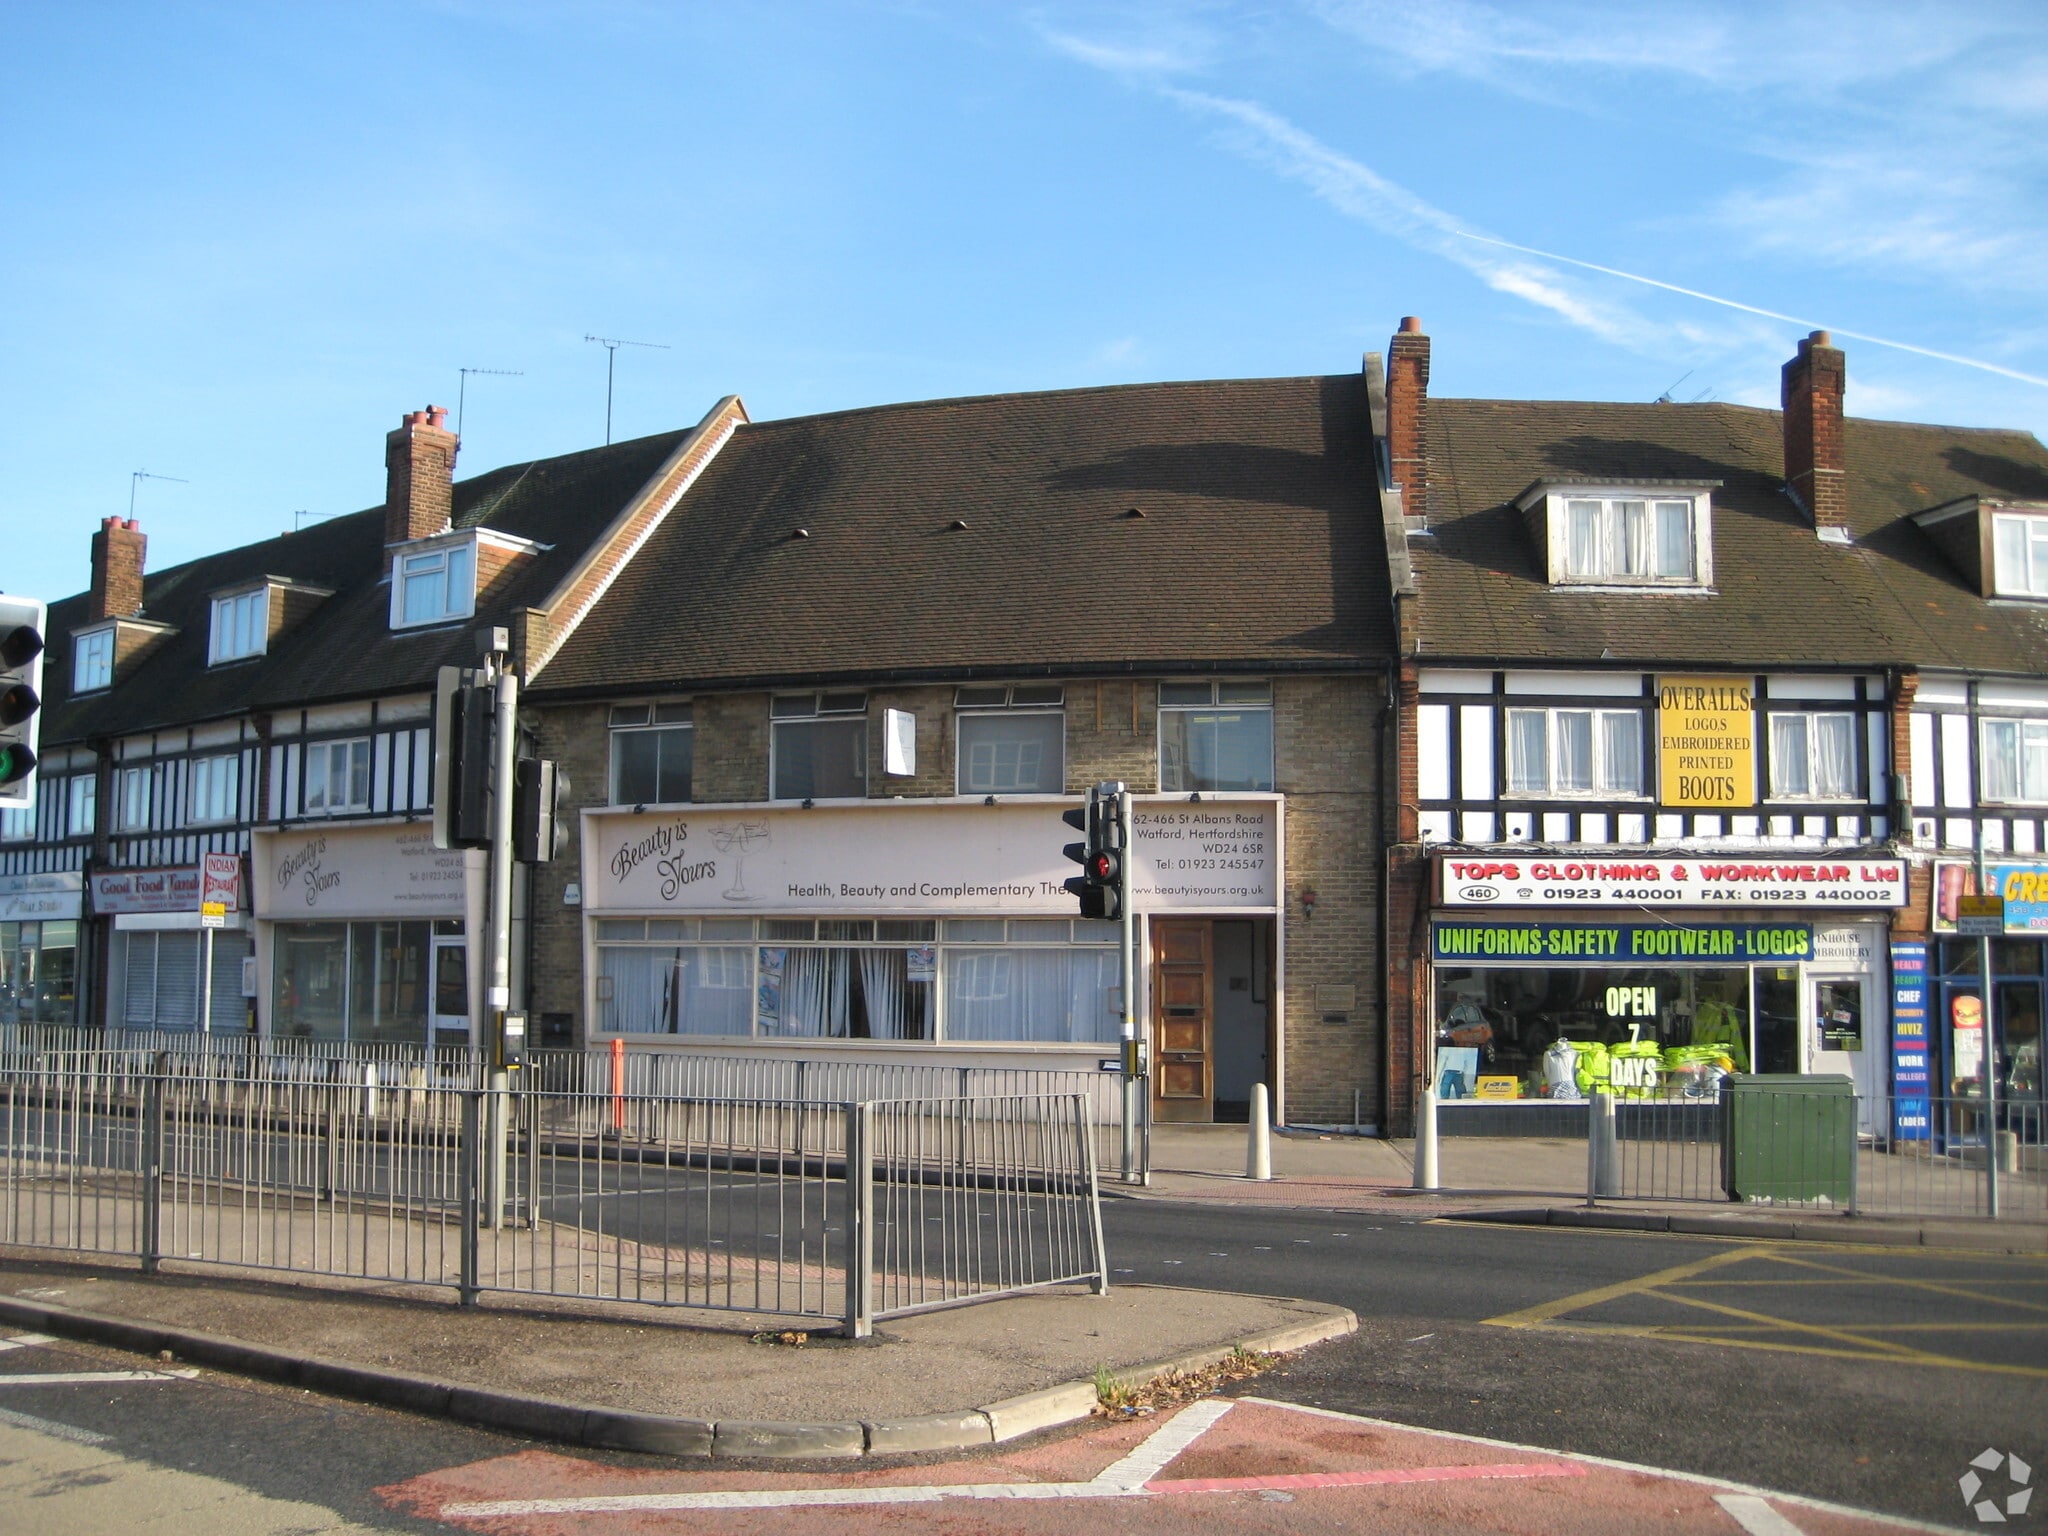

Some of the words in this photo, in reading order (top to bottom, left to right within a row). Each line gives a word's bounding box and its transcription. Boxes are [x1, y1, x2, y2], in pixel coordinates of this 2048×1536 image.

[1661, 686, 1749, 712] OVERALLS
[1662, 736, 1750, 750] EMBROIDERED
[1679, 756, 1733, 769] PRINTED
[1679, 776, 1735, 801] BOOTS
[1133, 814, 1175, 824] 62-466
[1179, 814, 1189, 824] St
[1192, 814, 1232, 824] Albans
[1235, 814, 1264, 824] Road
[1137, 828, 1185, 840] Watford,
[1189, 828, 1264, 839] Hertfordshire
[611, 824, 672, 883] Beauty
[675, 818, 687, 840] is
[1203, 844, 1238, 854] WD24
[1242, 844, 1264, 854] 6SR
[208, 858, 235, 872] INDIAN
[1155, 859, 1174, 869] Tel:
[1178, 859, 1215, 869] 01923
[1220, 859, 1264, 869] 245547
[442, 870, 463, 880] 24554
[657, 849, 716, 901] Yours
[1450, 863, 1520, 880] TOPS
[1530, 864, 1660, 881] CLOTHING
[1670, 864, 1689, 881] &
[1699, 864, 1850, 882] WORKWEAR
[1861, 866, 1899, 882] Ltd
[100, 877, 130, 895] Good
[135, 874, 164, 893] Food
[206, 874, 239, 896] RESTAURANT
[788, 883, 835, 898] Health,
[840, 884, 886, 899] Beauty
[896, 882, 916, 896] and
[920, 882, 1035, 899] Complementary
[1132, 885, 1264, 897] ww.beautyisyours.org.uk
[1467, 889, 1491, 898] 460
[1543, 888, 1601, 899] 01923
[1611, 888, 1682, 899] 440001
[1701, 889, 1741, 900] FAX:
[1750, 889, 1806, 900] 01923
[1815, 889, 1891, 900] 440002
[1817, 933, 1861, 943] INHOUSE
[1813, 947, 1871, 957] MBROIDERY
[1893, 960, 1923, 970] HEALTH
[1894, 975, 1922, 985] BEAUTY
[1606, 987, 1656, 1016] OPEN
[1897, 990, 1921, 1003] CHEF
[1897, 1022, 1923, 1035] HIVIZ
[1628, 1023, 1640, 1052] 7
[1897, 1055, 1924, 1067] WORK
[1610, 1057, 1657, 1087] DAYS
[1896, 1072, 1927, 1081] COLLEGES
